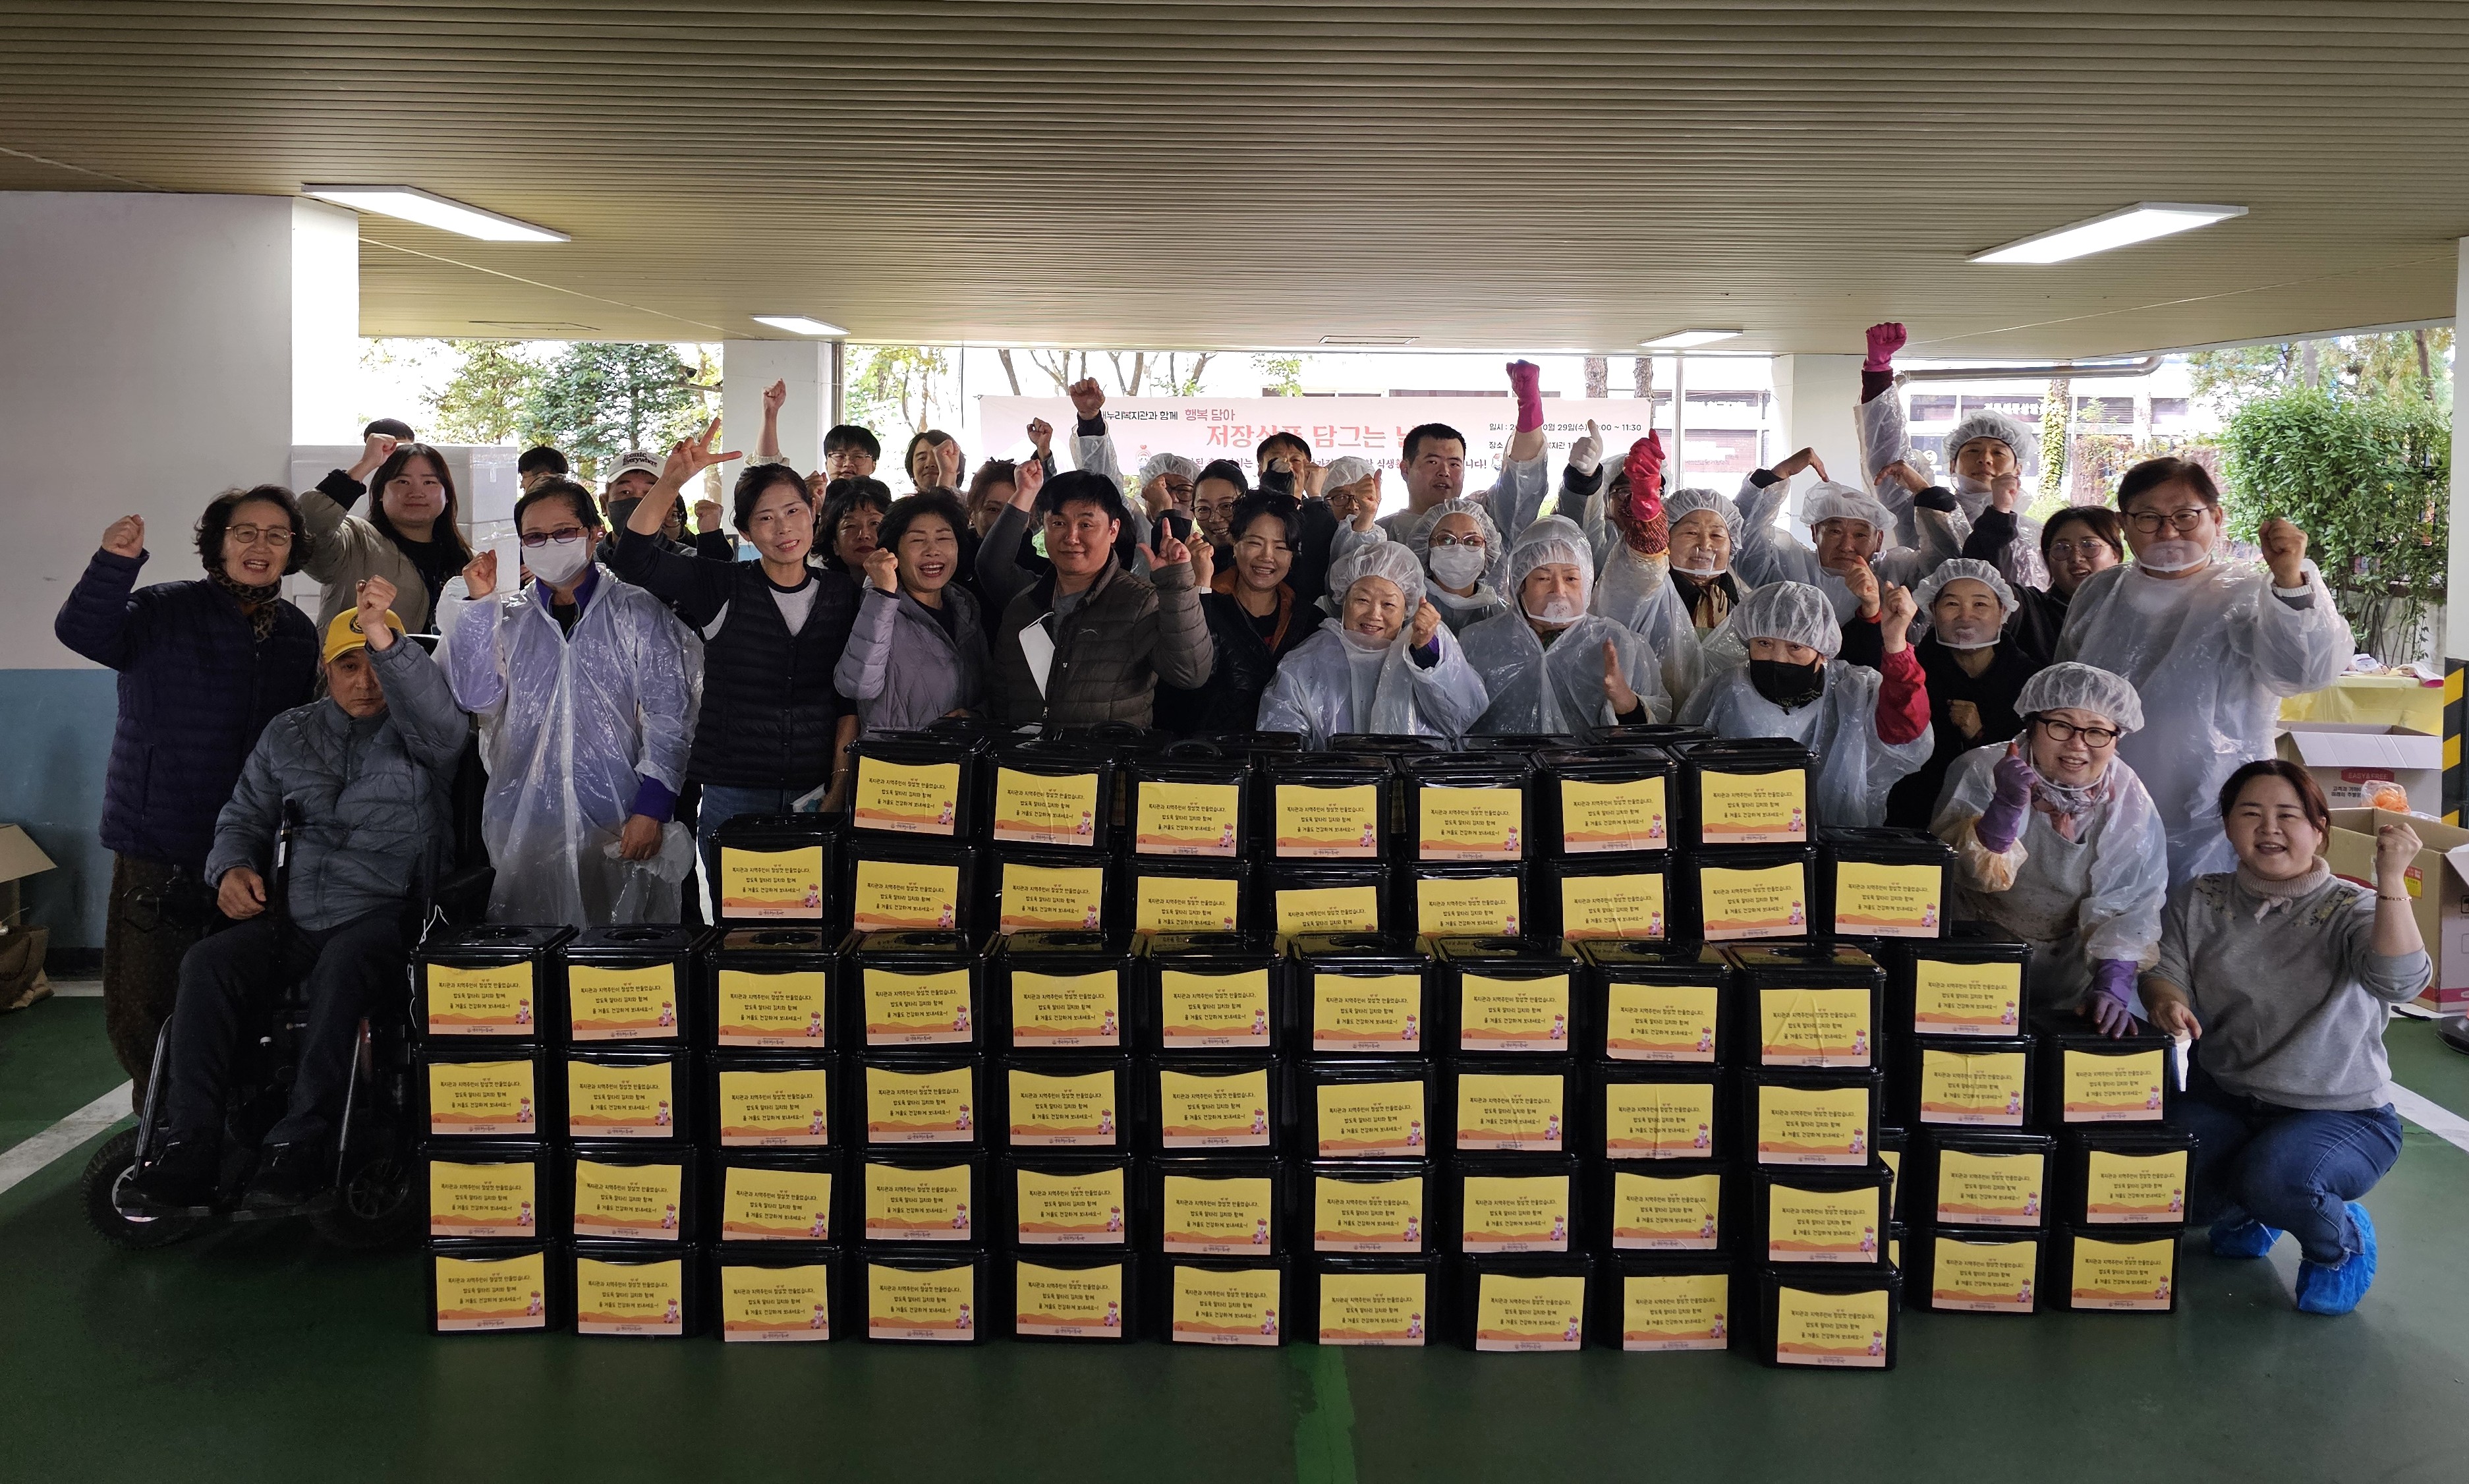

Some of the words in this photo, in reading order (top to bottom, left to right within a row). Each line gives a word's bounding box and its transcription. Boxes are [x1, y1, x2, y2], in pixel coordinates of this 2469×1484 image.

[1160, 411, 1178, 420] 함께
[1185, 409, 1208, 421] 행복
[1212, 409, 1235, 421] 담아
[1313, 425, 1386, 448] 담그는
[623, 457, 658, 468] Everywhere
[1466, 459, 1487, 469] 니다!
